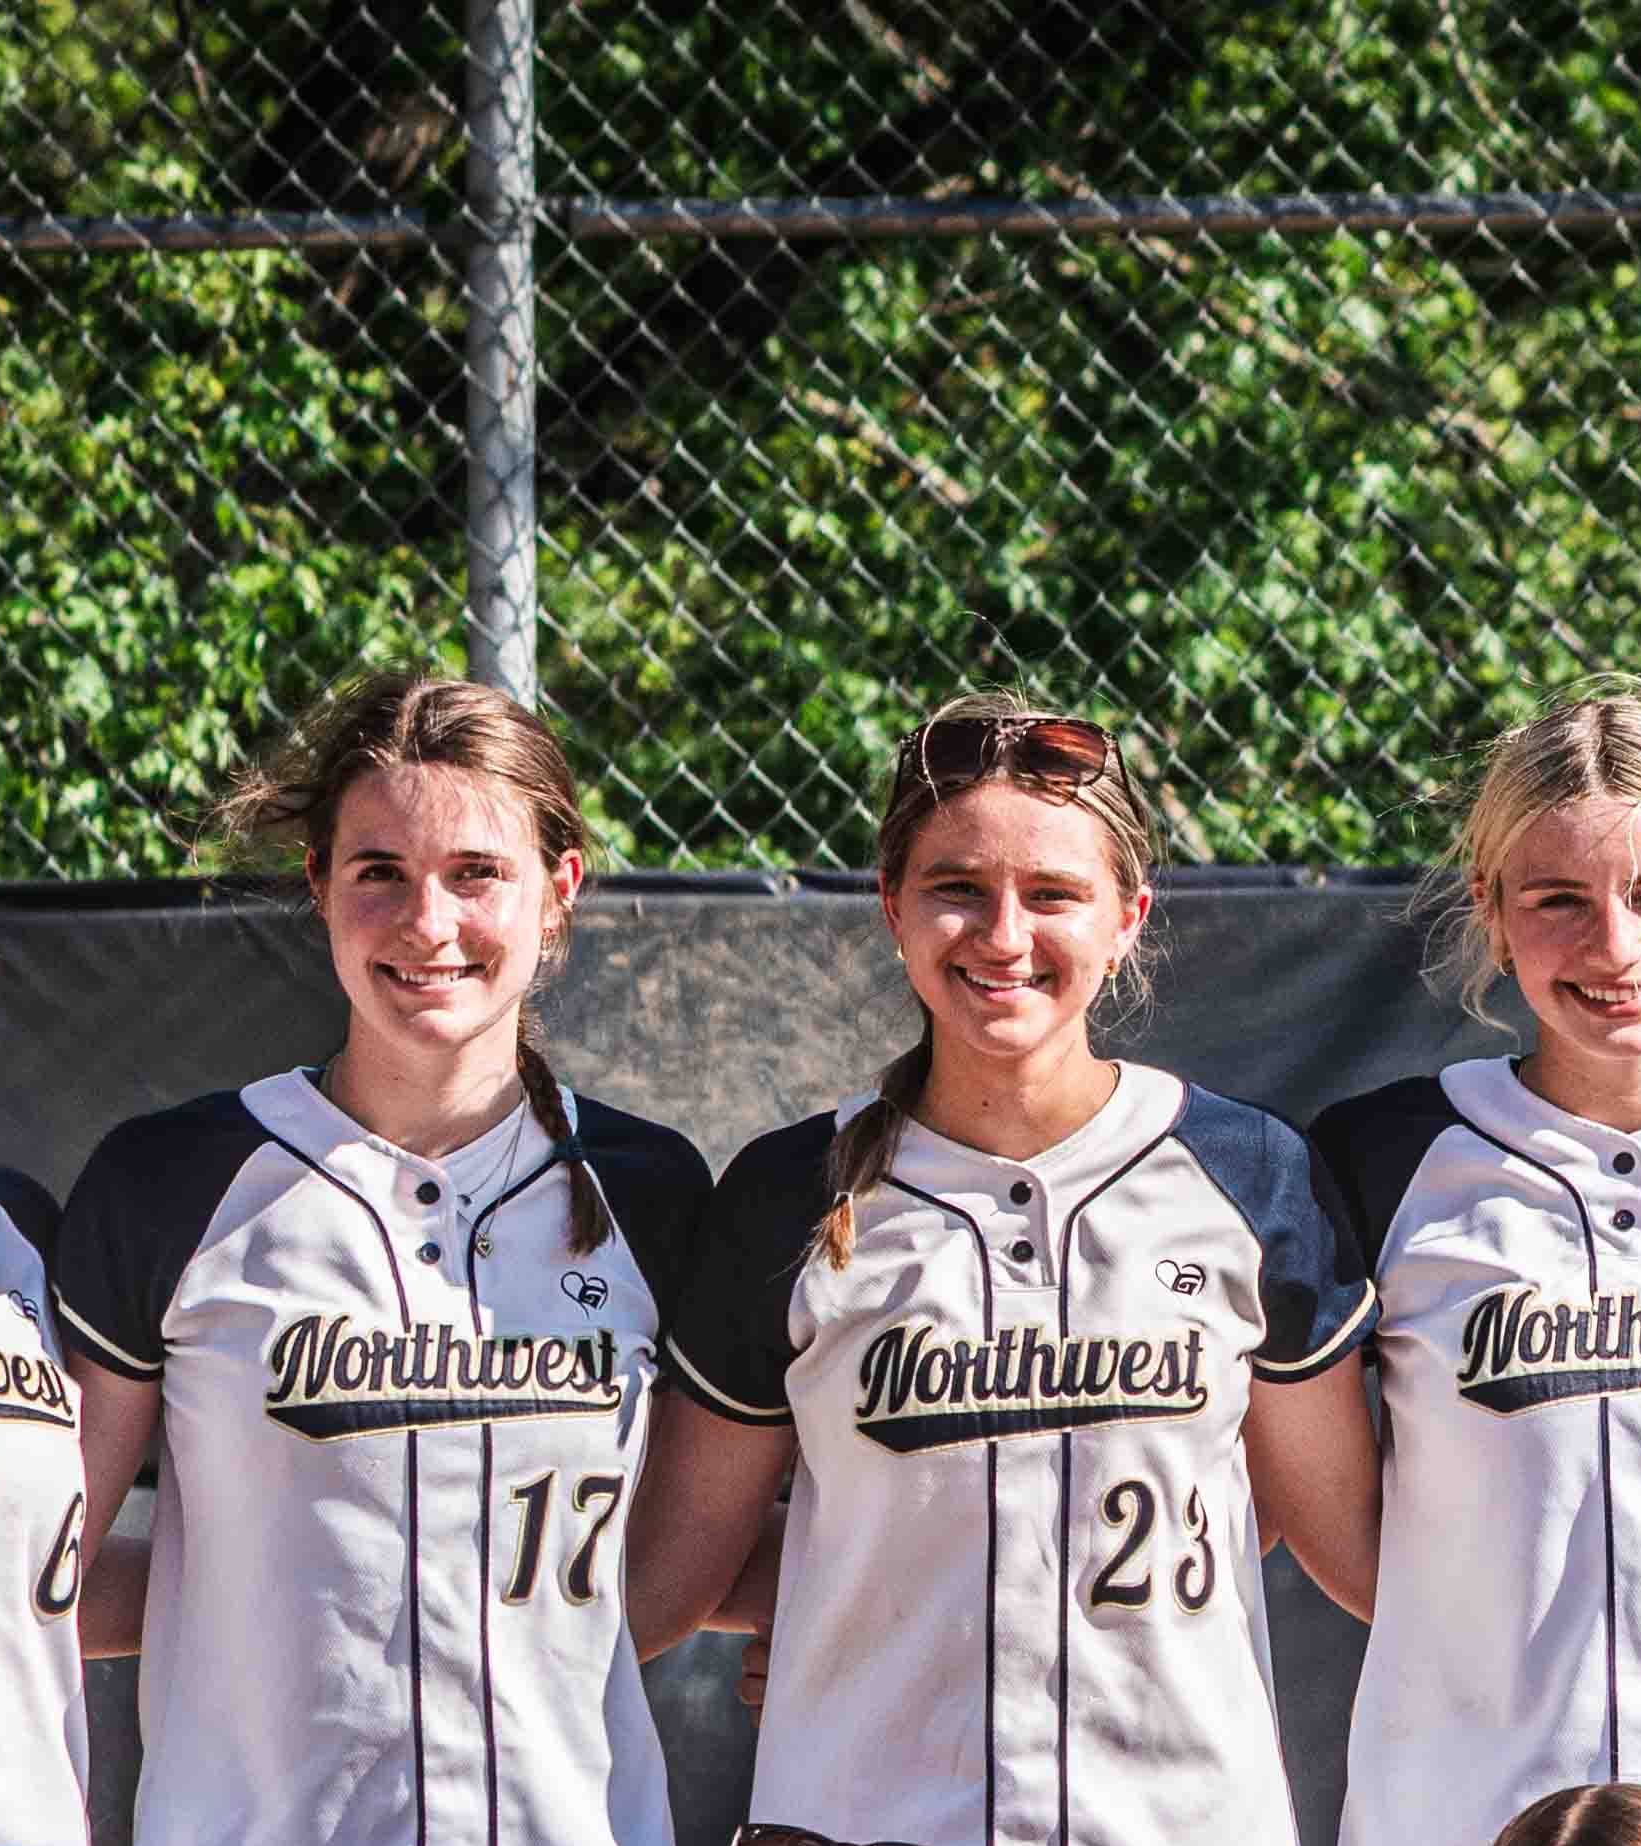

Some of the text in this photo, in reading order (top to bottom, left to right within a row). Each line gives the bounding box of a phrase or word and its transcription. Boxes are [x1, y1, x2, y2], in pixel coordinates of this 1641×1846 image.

[263, 1311, 622, 1404] Northwest
[853, 1320, 1208, 1420] Northwest
[29, 1491, 86, 1619] 6
[497, 1469, 627, 1608] 17
[1089, 1479, 1217, 1617] 23
